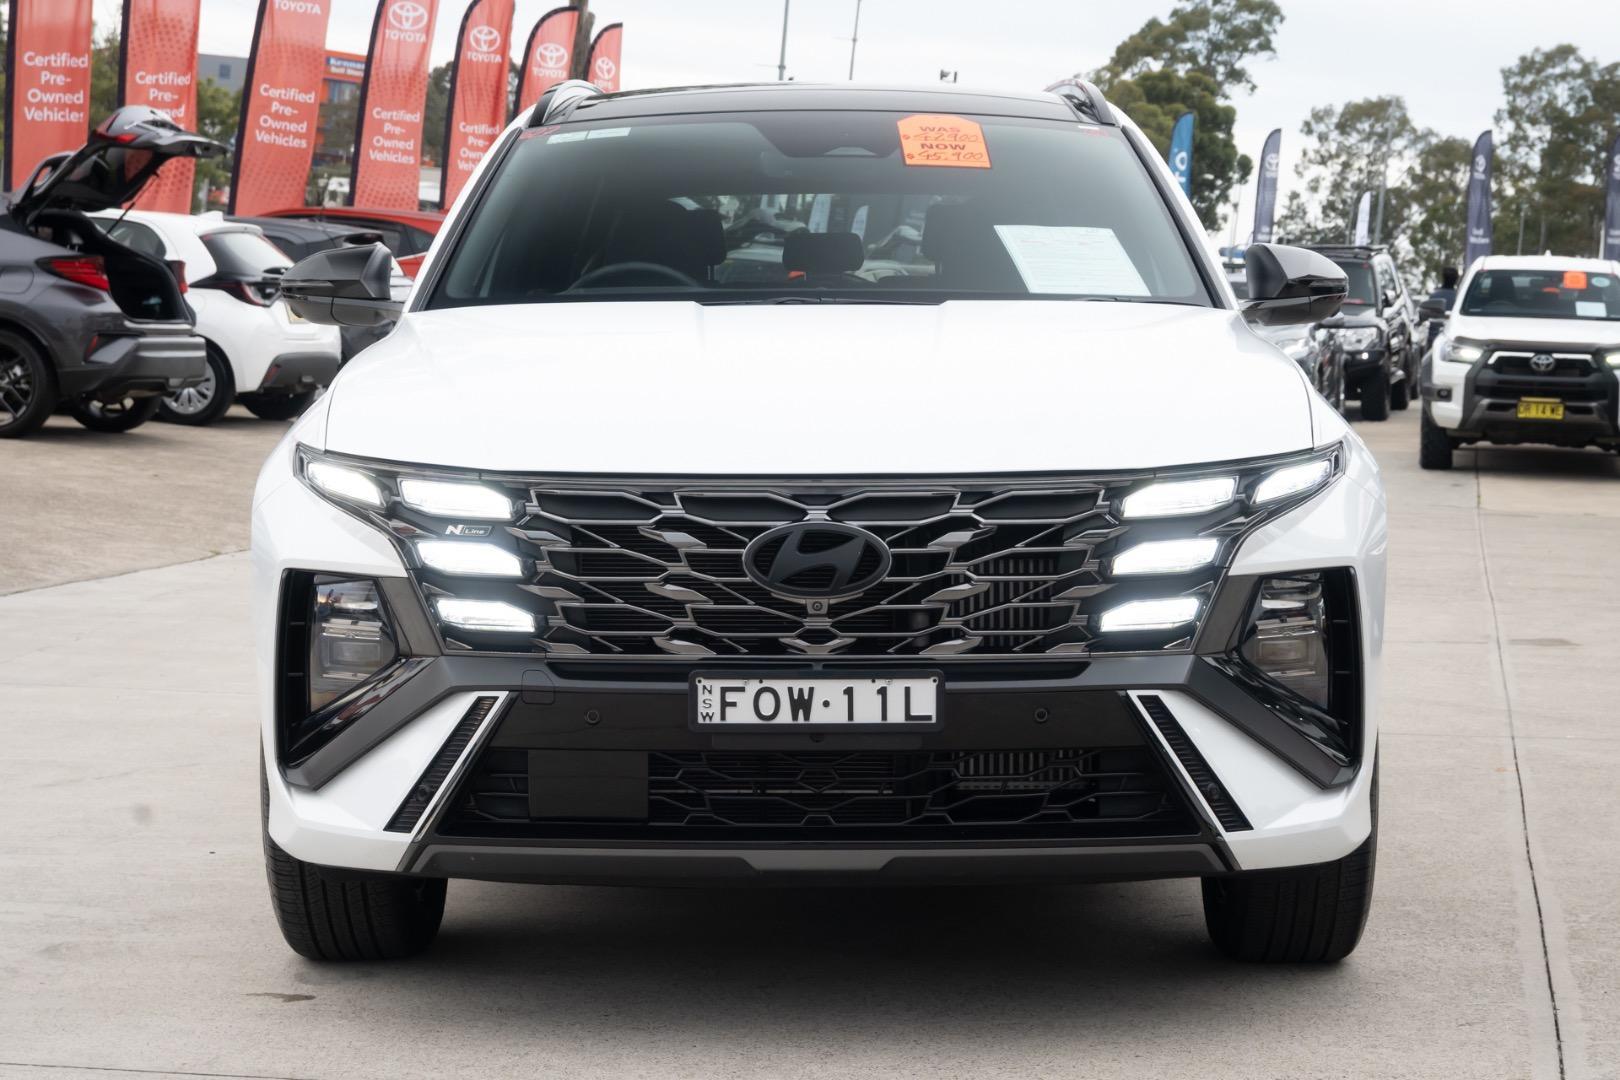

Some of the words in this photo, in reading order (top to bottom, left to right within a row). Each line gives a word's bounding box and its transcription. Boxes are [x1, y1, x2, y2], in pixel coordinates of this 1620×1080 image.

[274, 0, 321, 15] TOYOTA
[385, 29, 427, 43] TOYOTA
[23, 51, 89, 68] Certified
[467, 51, 503, 63] TOYOTA
[40, 70, 72, 86] Pre-
[135, 70, 192, 86] Certified
[27, 88, 84, 104] Owned
[149, 87, 179, 102] Pre-
[260, 84, 315, 104] Certified
[271, 100, 299, 117] Pre-
[372, 107, 421, 123] Certified
[259, 115, 308, 133] Owned
[383, 122, 406, 135] Pre-
[459, 121, 500, 136] Certified
[255, 129, 308, 149] Vehicles
[372, 136, 415, 151] Owned
[369, 148, 415, 164] Vehicles
[460, 147, 485, 159] Own
[700, 685, 715, 722] NSW
